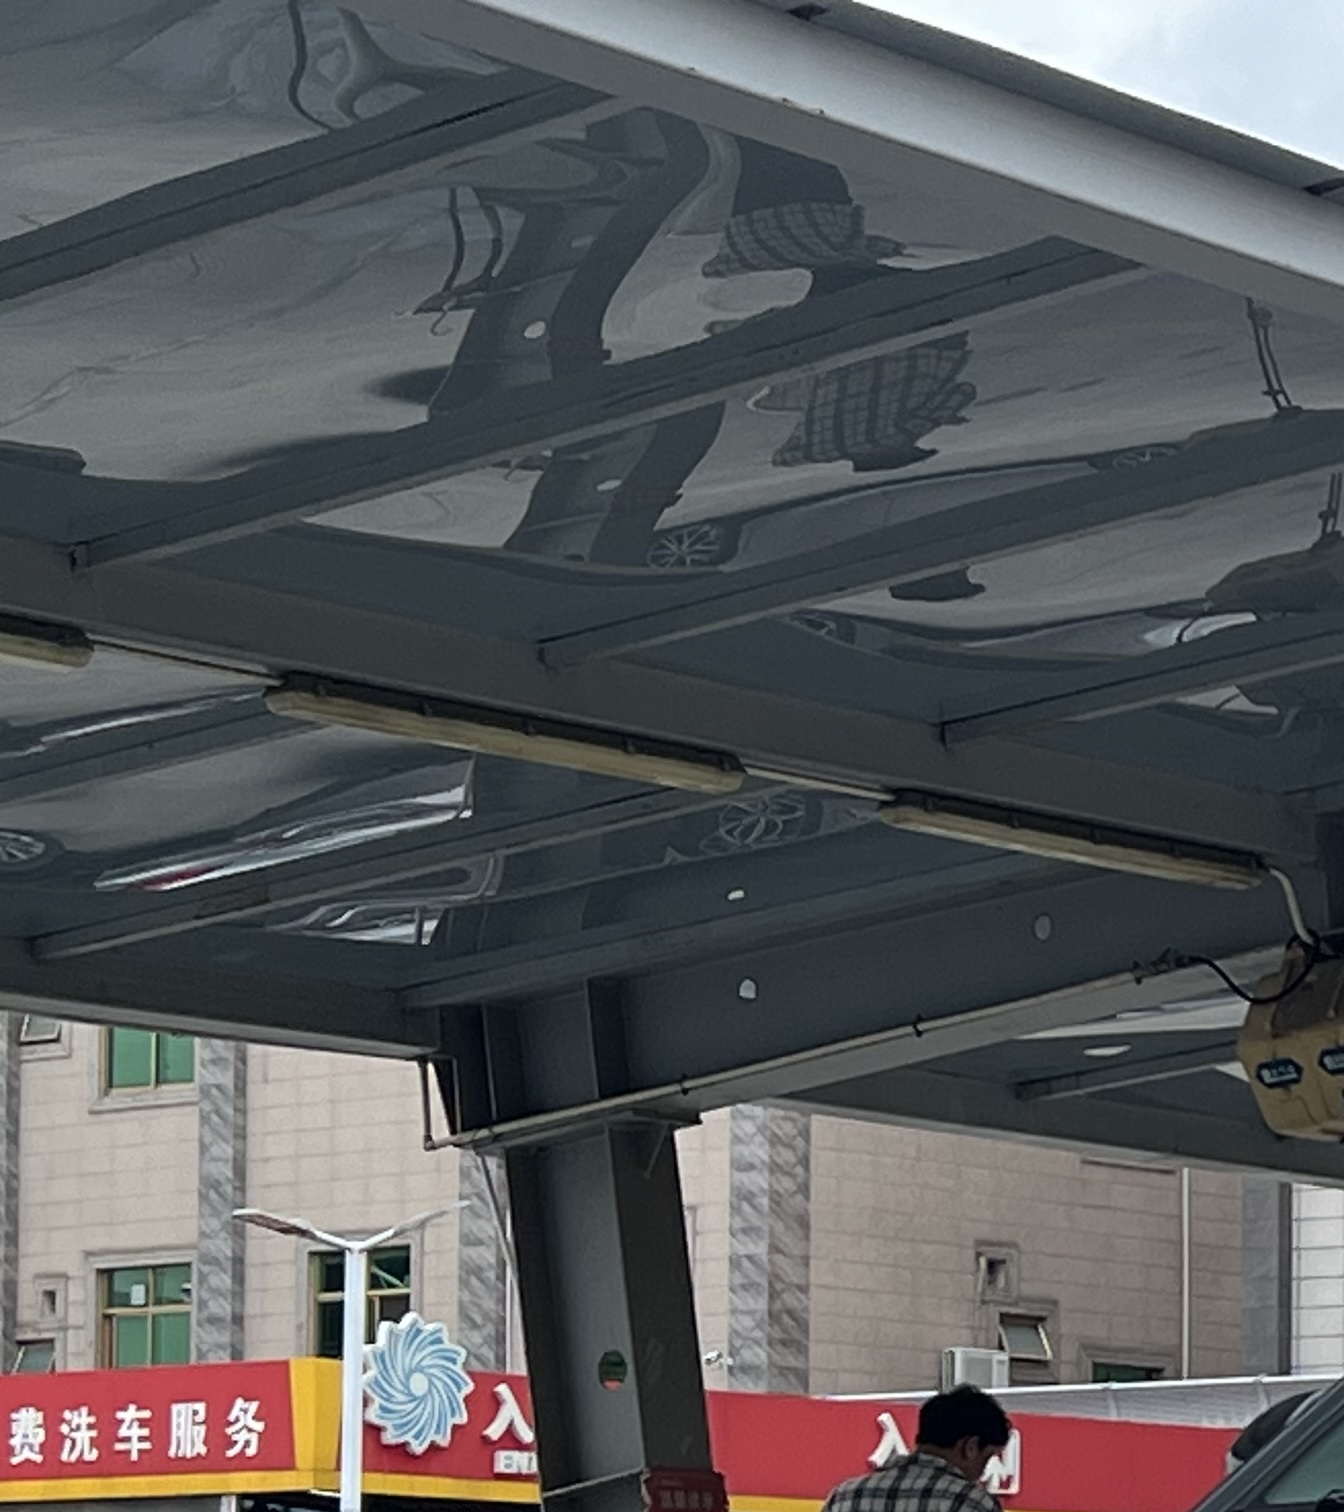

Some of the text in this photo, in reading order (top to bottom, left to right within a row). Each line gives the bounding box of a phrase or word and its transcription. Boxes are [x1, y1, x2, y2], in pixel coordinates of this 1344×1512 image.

[8, 1397, 265, 1464] 费洗车服务
